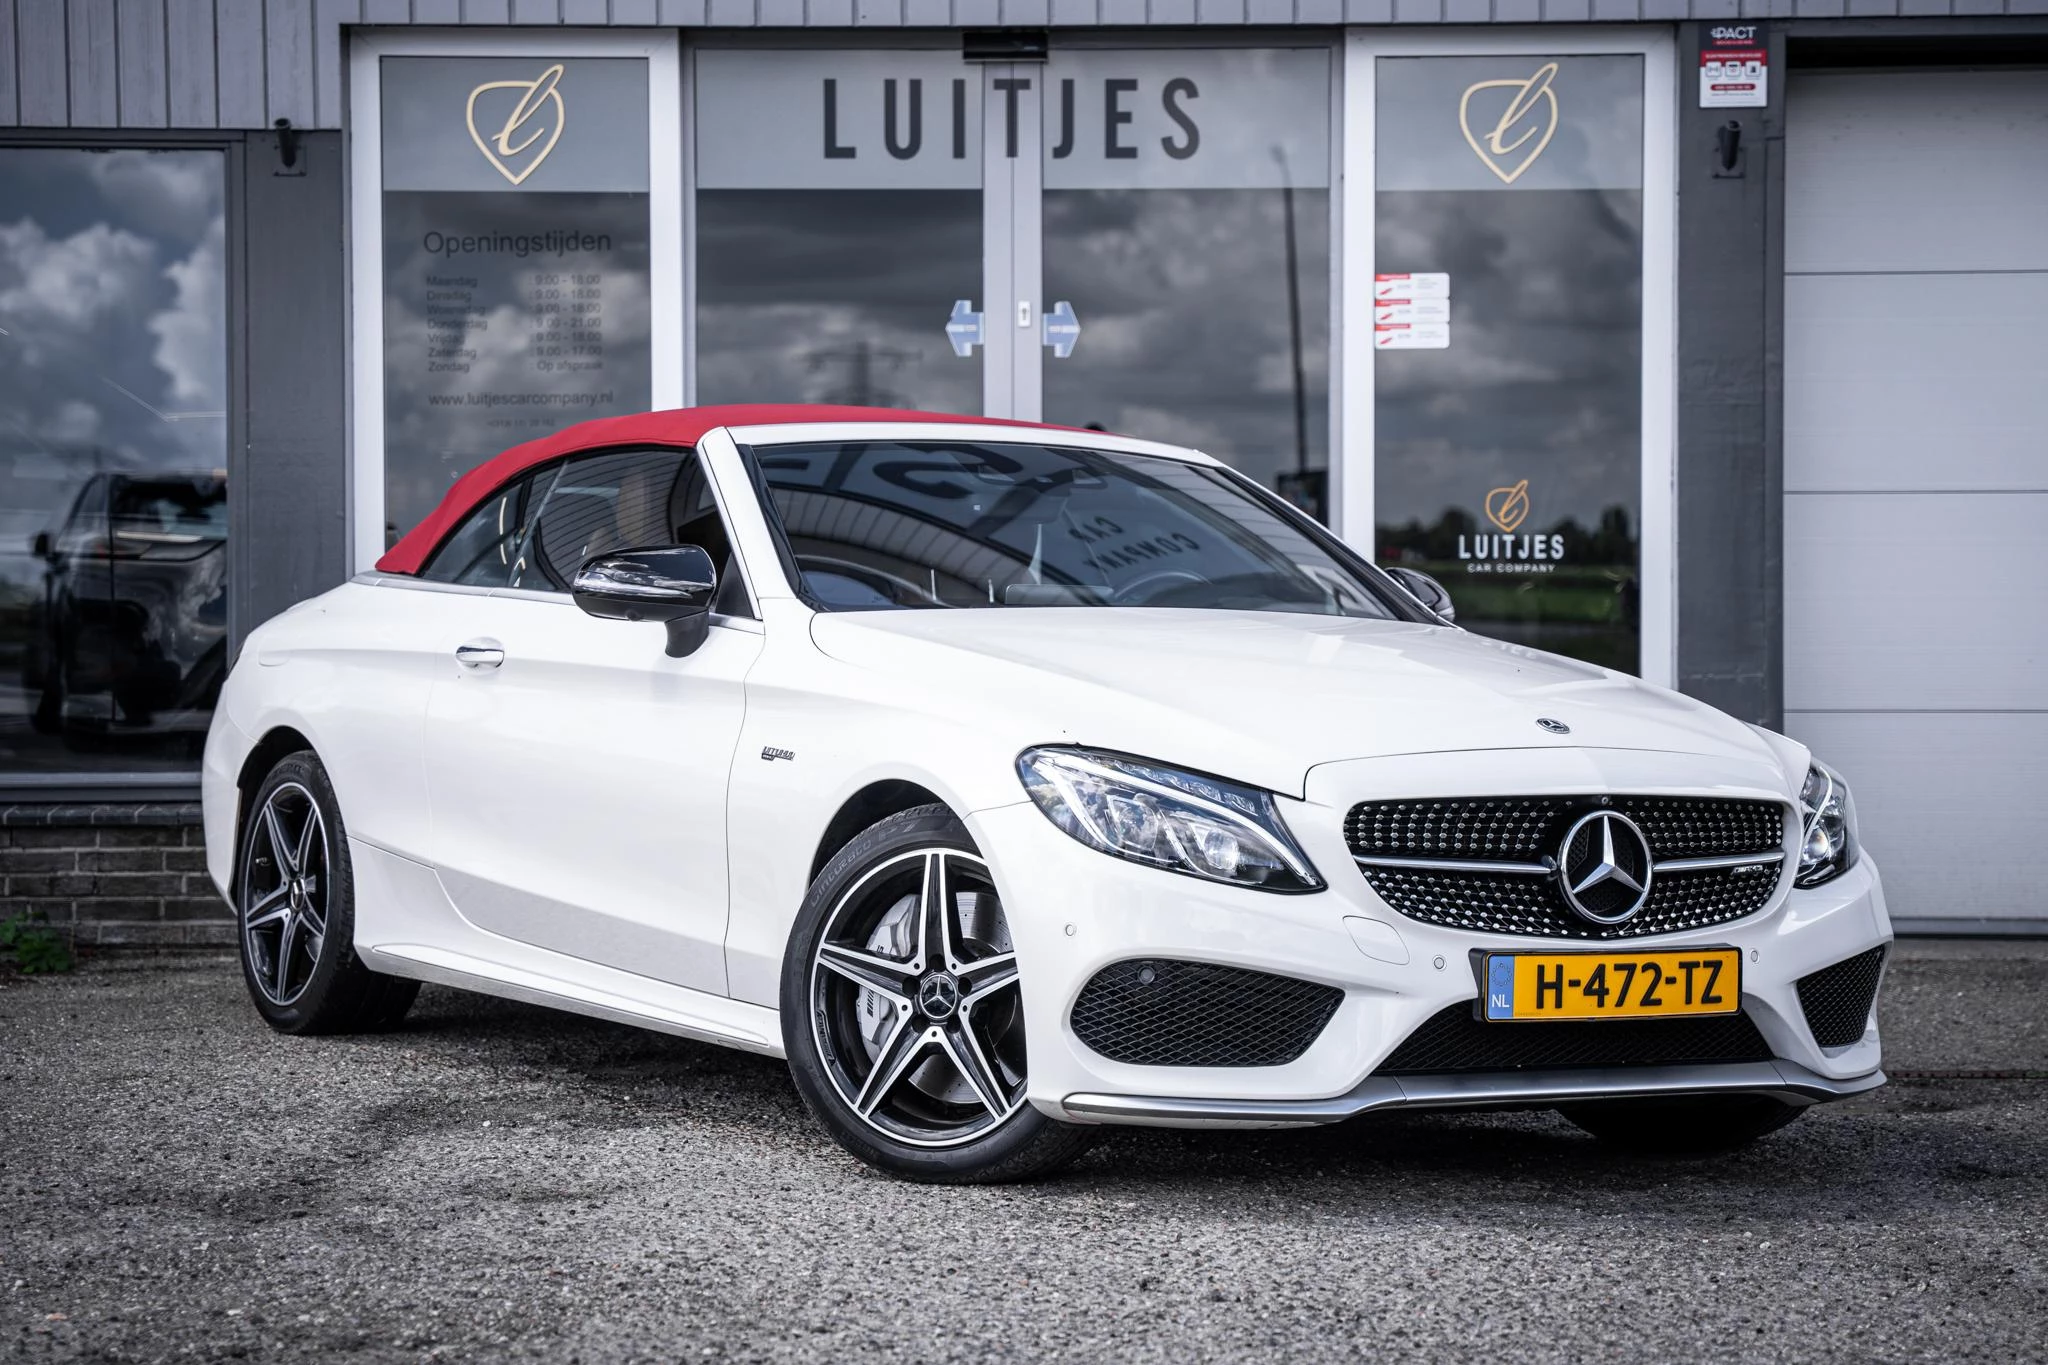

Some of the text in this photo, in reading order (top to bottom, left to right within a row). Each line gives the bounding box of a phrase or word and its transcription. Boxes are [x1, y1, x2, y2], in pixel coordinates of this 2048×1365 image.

[823, 77, 1201, 160] LUITJES
[423, 230, 612, 258] Openingstijden
[426, 276, 478, 288] Maandag
[428, 362, 470, 374] Zondag
[537, 360, 553, 371] Op
[429, 391, 613, 407] www.luitjescarcompany.nl
[1459, 534, 1565, 560] LUITJES
[1467, 563, 1556, 573] CAR COMPANY
[1536, 959, 1723, 1010] H-472-TZ
[1491, 994, 1510, 1008] NL
